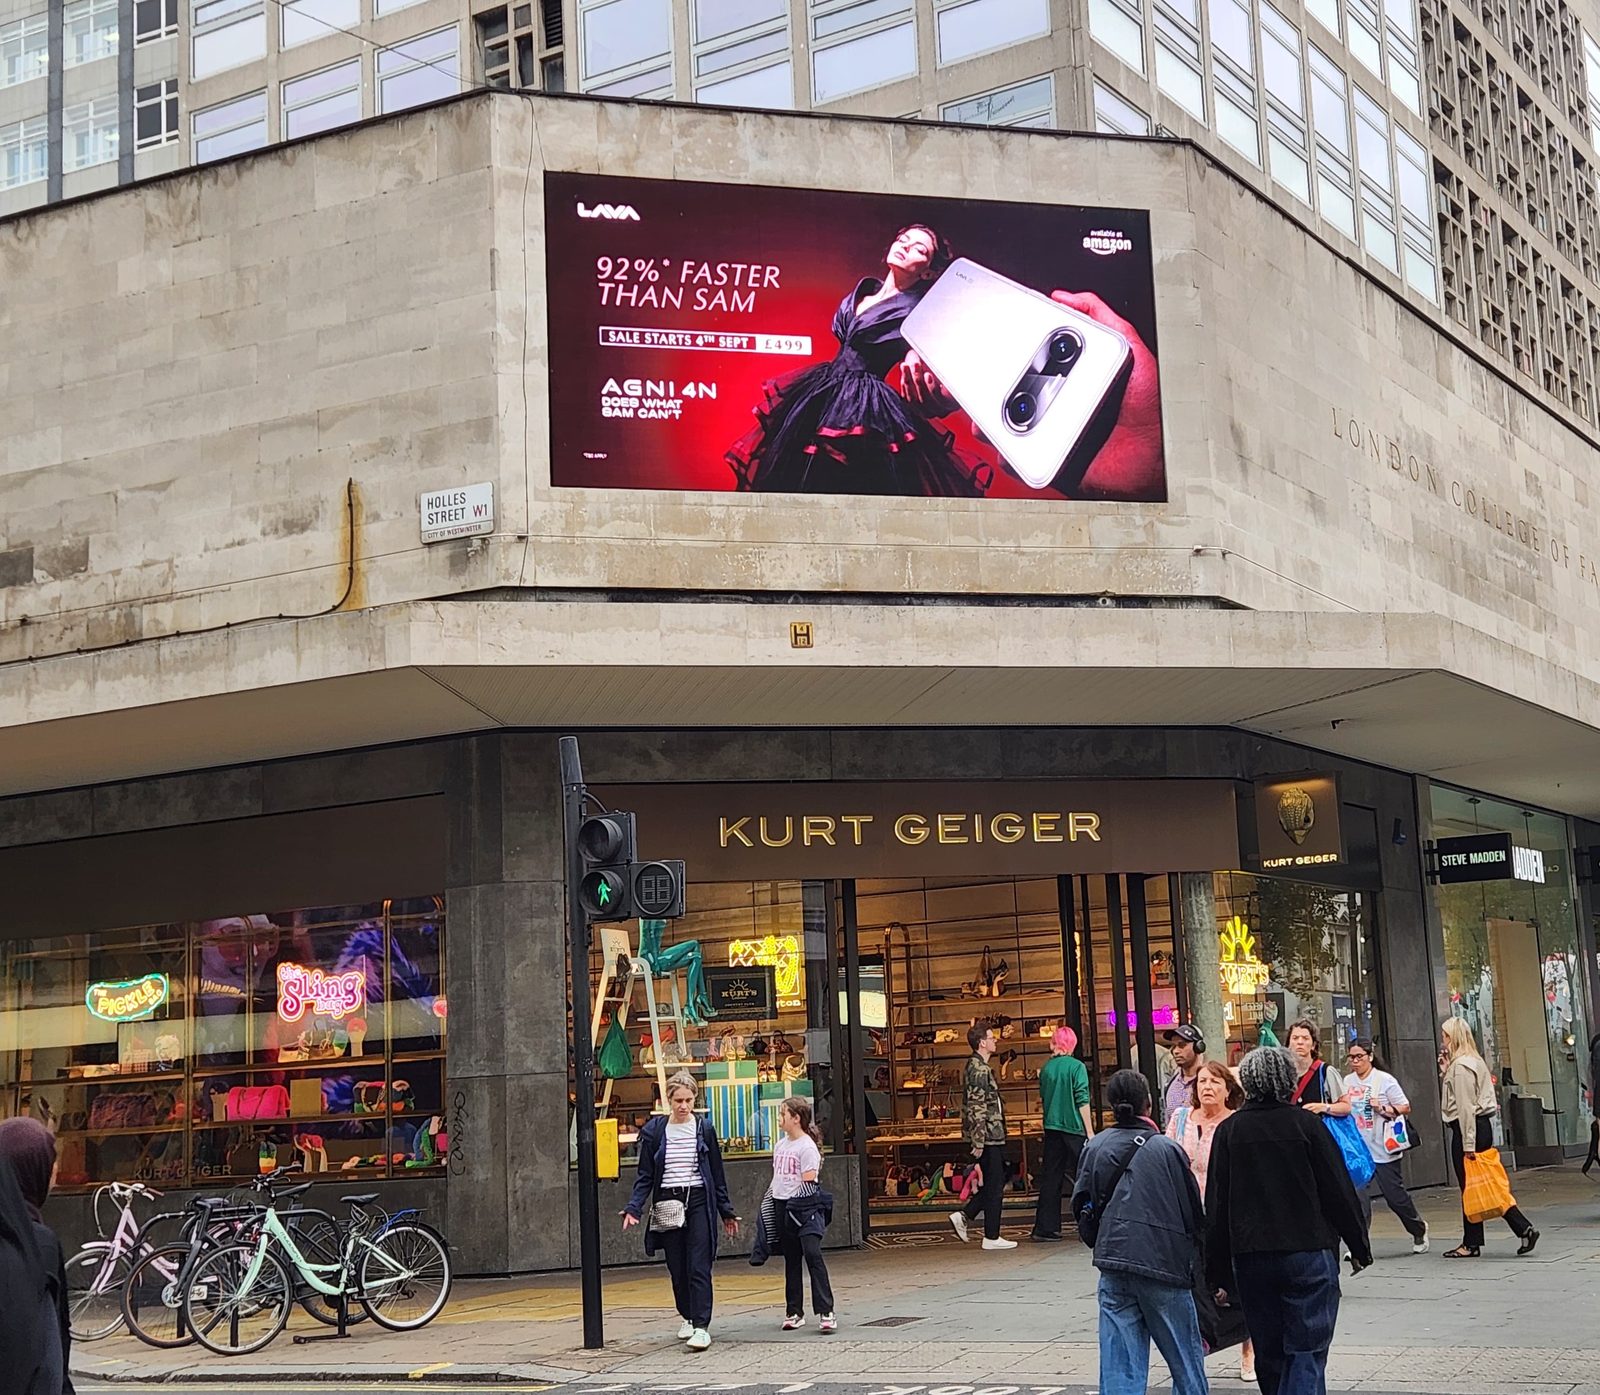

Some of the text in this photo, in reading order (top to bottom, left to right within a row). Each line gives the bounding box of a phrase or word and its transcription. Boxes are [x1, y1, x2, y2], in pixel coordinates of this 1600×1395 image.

[577, 202, 641, 221] LAVA
[1083, 236, 1132, 254] amazon
[680, 260, 780, 288] FASTER
[597, 282, 756, 312] THAN SAM
[608, 330, 642, 345] SALE
[644, 332, 692, 347] STARTS
[718, 335, 749, 348] SEPT
[764, 338, 803, 351] £499
[601, 378, 717, 399] AGNI 4N
[601, 396, 683, 409] DOES WHAT
[601, 407, 682, 420] SAM CAN'T
[1331, 406, 1438, 495] LONDON
[1451, 480, 1541, 552] COLLEGE
[1551, 538, 1569, 569] OF
[427, 492, 466, 510] HOLLES
[427, 503, 488, 525] STREET W1
[447, 524, 482, 536] WESTMINSTER
[794, 624, 810, 645] H
[719, 811, 1102, 848] KURT GEIGER
[1263, 853, 1338, 868] KURT GEIGER
[1441, 850, 1506, 867] STEVE MADDEN
[280, 966, 302, 980] the
[97, 980, 156, 1015] PICKLE
[282, 972, 360, 1016] Sling
[721, 989, 757, 998] KURT'S
[134, 1164, 232, 1179] KURT GEIGER
